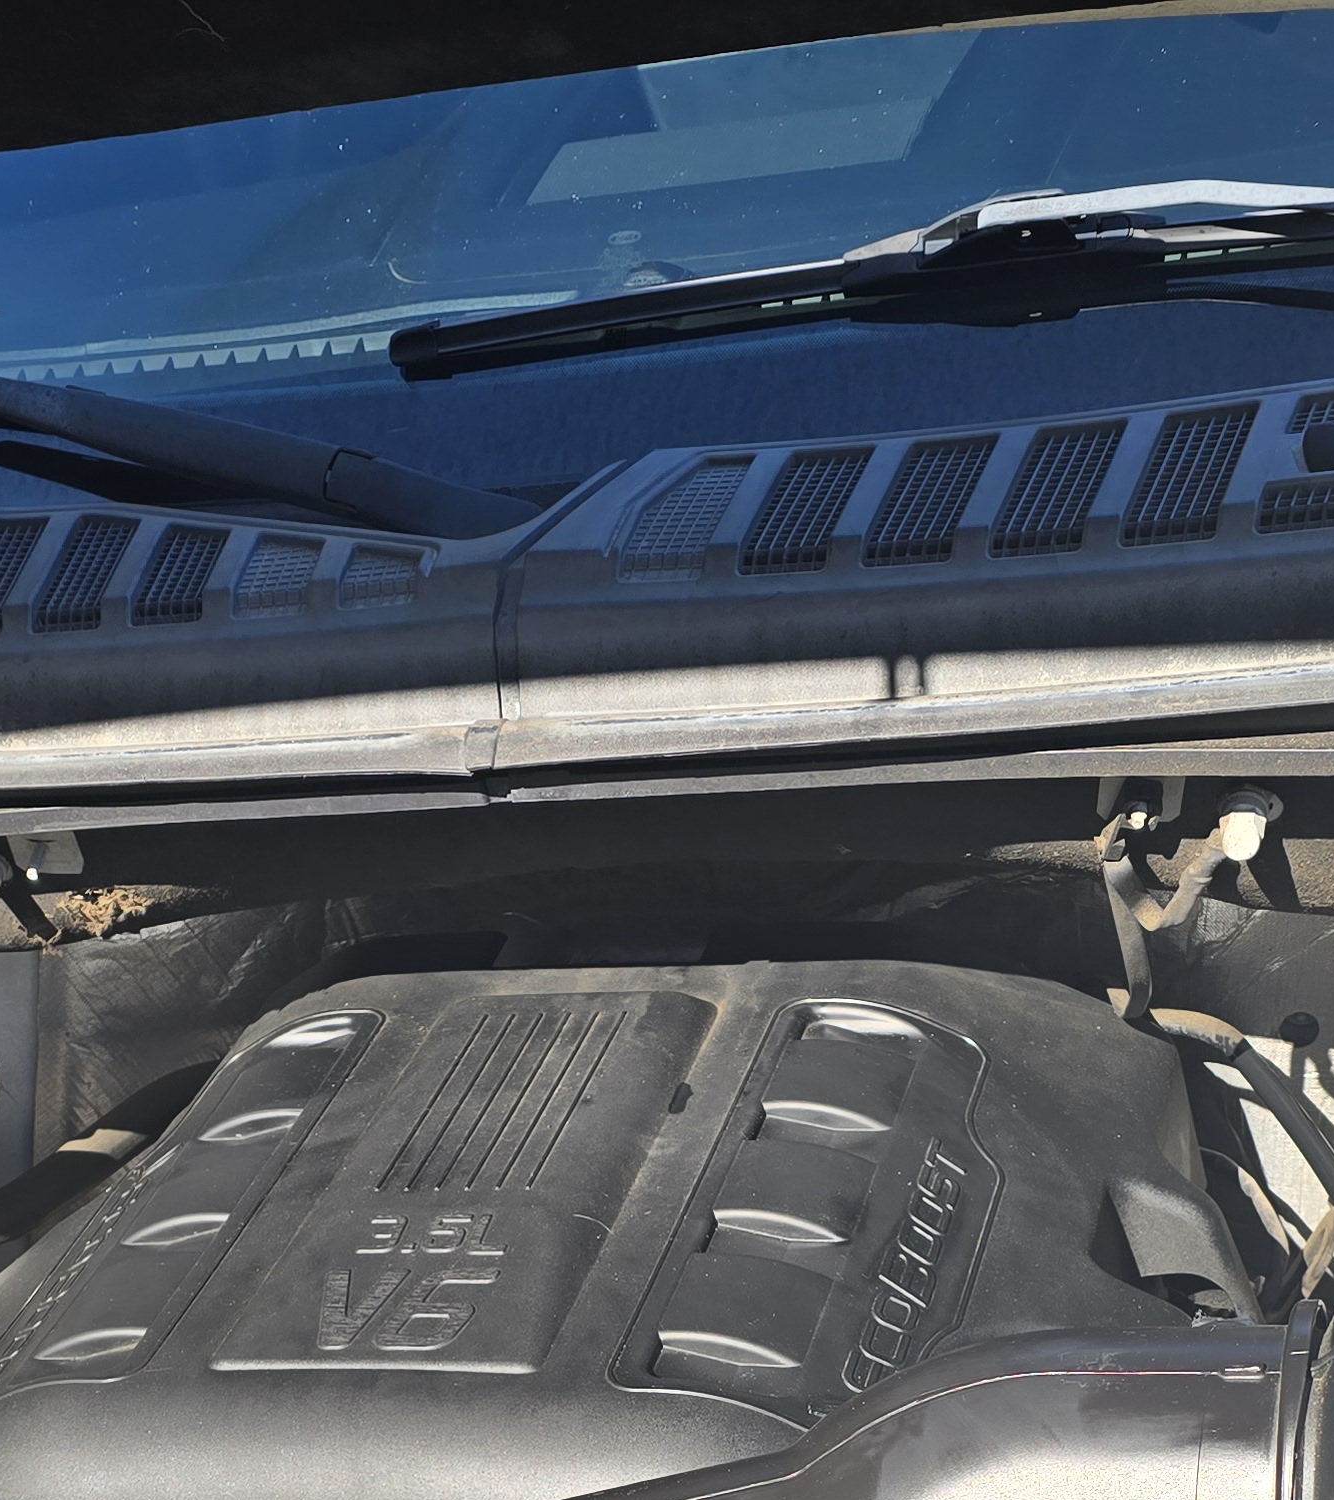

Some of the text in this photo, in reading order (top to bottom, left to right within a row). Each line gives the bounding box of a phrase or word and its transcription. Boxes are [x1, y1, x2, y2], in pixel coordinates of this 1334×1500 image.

[356, 1213, 509, 1256] 3.5L
[841, 1136, 969, 1395] ECOBOOST
[317, 1268, 502, 1351] V6
